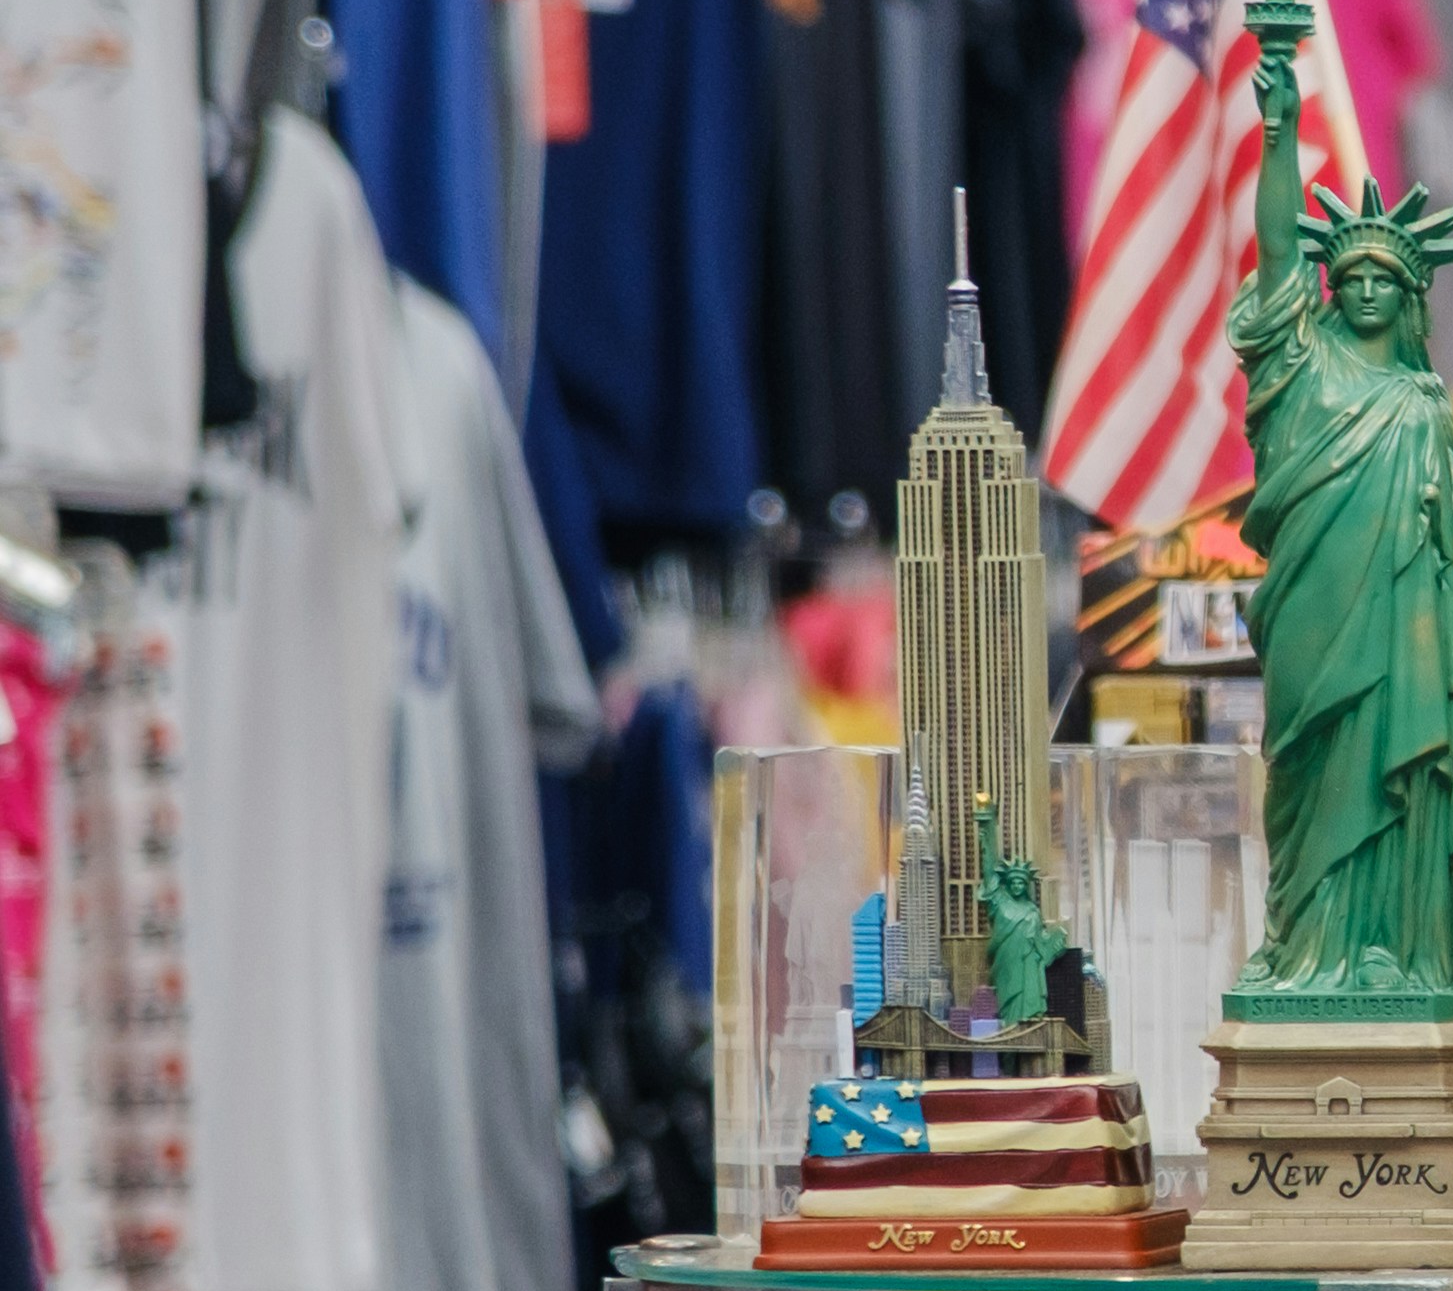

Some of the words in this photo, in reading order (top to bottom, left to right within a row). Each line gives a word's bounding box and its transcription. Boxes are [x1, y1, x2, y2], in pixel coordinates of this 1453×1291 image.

[1251, 997, 1320, 1017] STATUE
[1324, 997, 1348, 1017] OF
[1351, 996, 1427, 1017] LIBERTY
